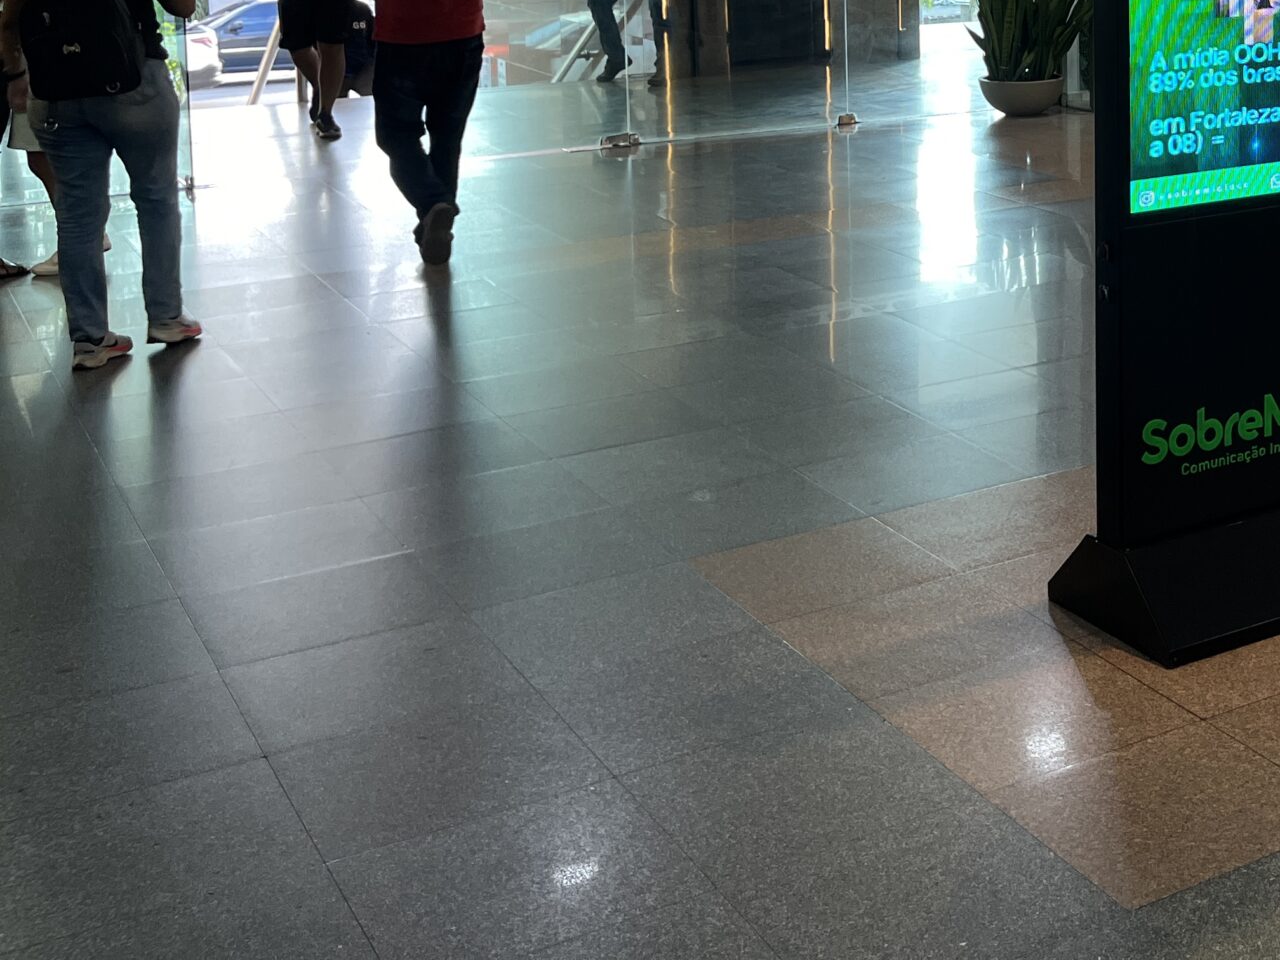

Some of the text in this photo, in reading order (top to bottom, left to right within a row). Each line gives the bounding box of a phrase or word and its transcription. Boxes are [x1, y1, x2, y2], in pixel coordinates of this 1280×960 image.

[1150, 50, 1168, 72] A
[1150, 69, 1195, 93] 89%
[1200, 68, 1238, 88] dos
[1150, 116, 1185, 136] em
[1150, 139, 1164, 157] a
[1181, 445, 1266, 476] Comunicação
